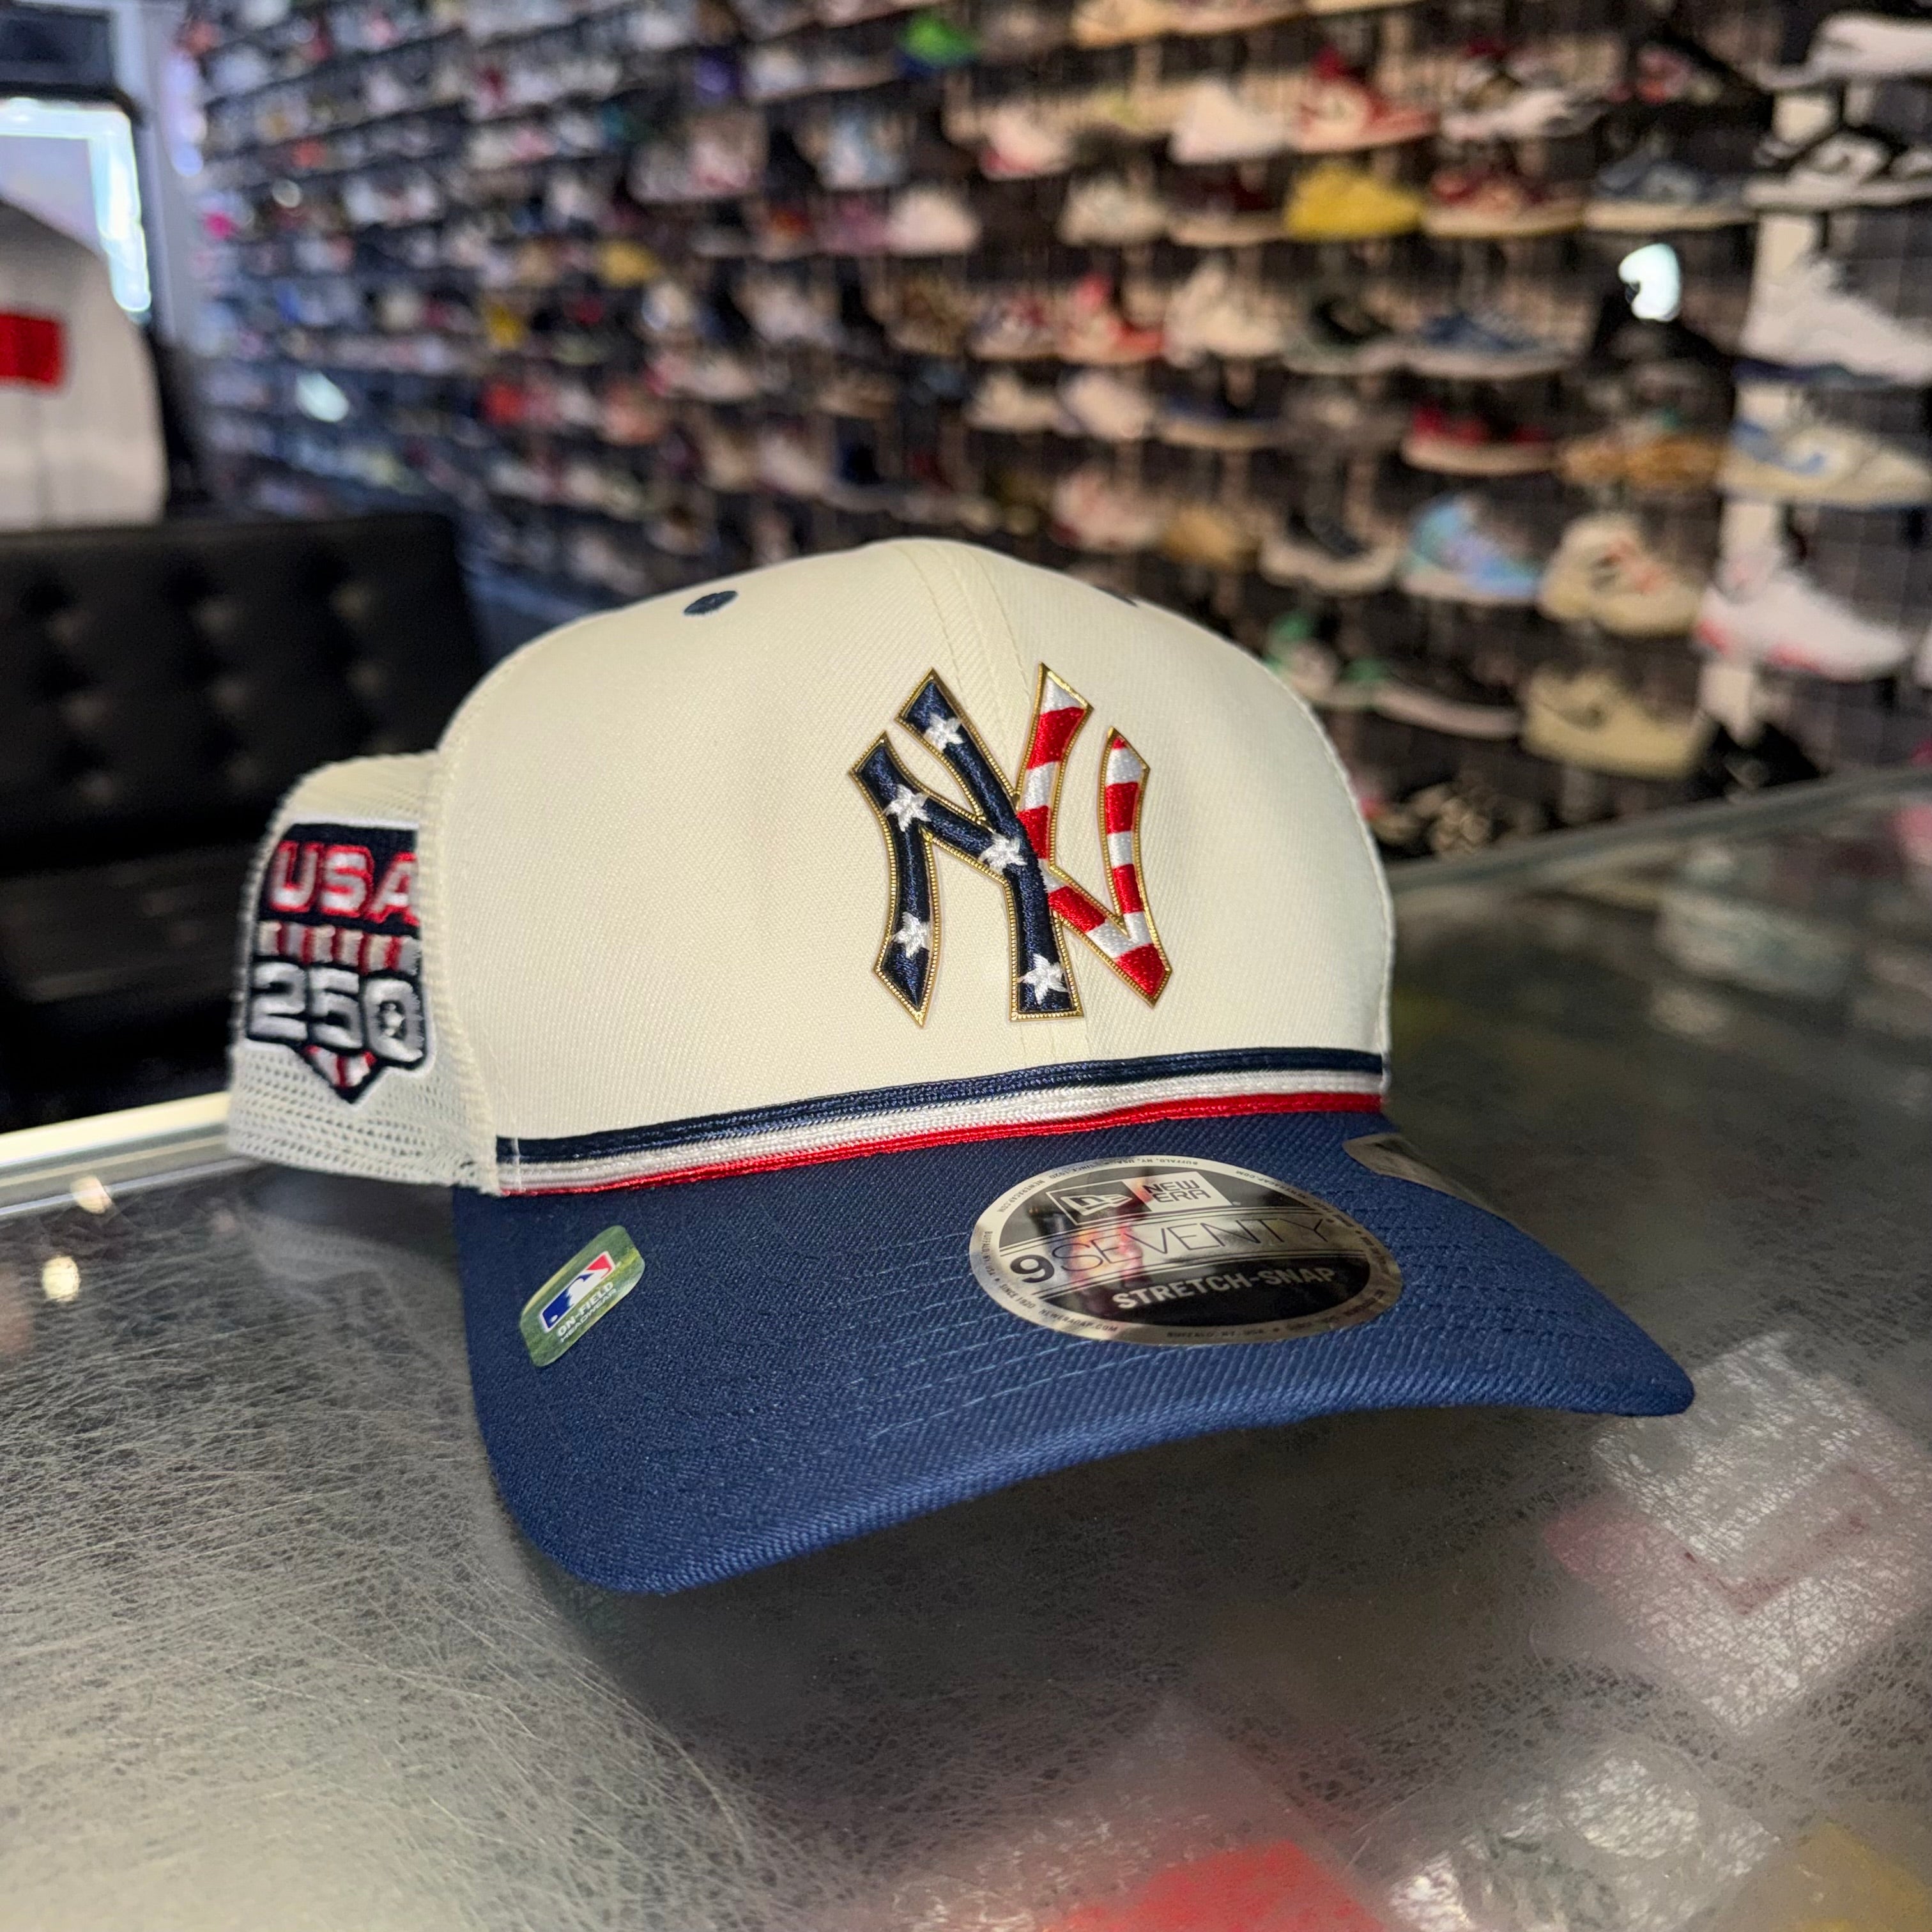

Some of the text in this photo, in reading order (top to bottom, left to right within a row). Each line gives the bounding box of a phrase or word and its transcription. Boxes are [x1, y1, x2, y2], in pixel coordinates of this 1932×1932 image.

[848, 661, 1173, 1028] NY
[270, 840, 420, 926] USA
[250, 962, 424, 1063] 250
[1142, 1179, 1201, 1194] NEW
[1151, 1189, 1211, 1203] ERA
[1009, 1217, 1328, 1284] 9SEVENTY
[557, 1281, 614, 1337] ON-FIELD
[560, 1287, 617, 1343] HEADWEAR
[999, 1283, 1019, 1299] SINCE
[1015, 1297, 1036, 1309] 1920
[1112, 1266, 1336, 1309] STRETCH-SNAP
